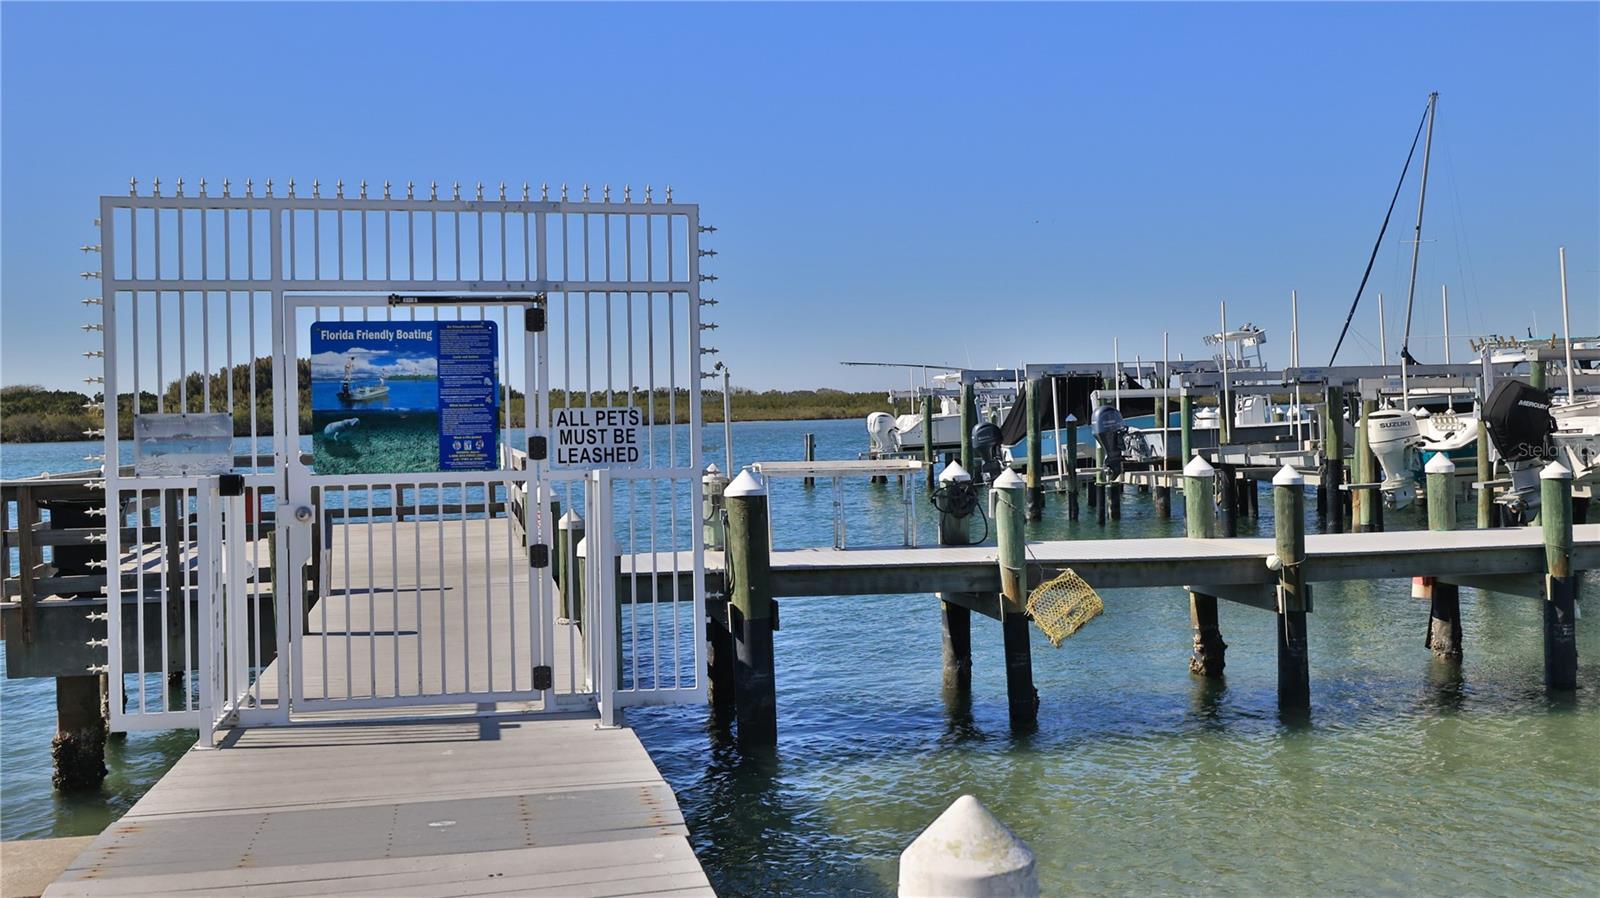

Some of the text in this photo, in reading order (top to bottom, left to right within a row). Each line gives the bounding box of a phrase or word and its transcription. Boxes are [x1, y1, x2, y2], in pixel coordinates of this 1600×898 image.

[321, 329, 433, 342] Florida Friendly Boating
[1518, 399, 1550, 410] MERCURY
[556, 410, 639, 427] ALL PETS
[1379, 420, 1411, 429] SUZUKI
[560, 428, 636, 445] MUST BE
[558, 446, 639, 464] LEASHED
